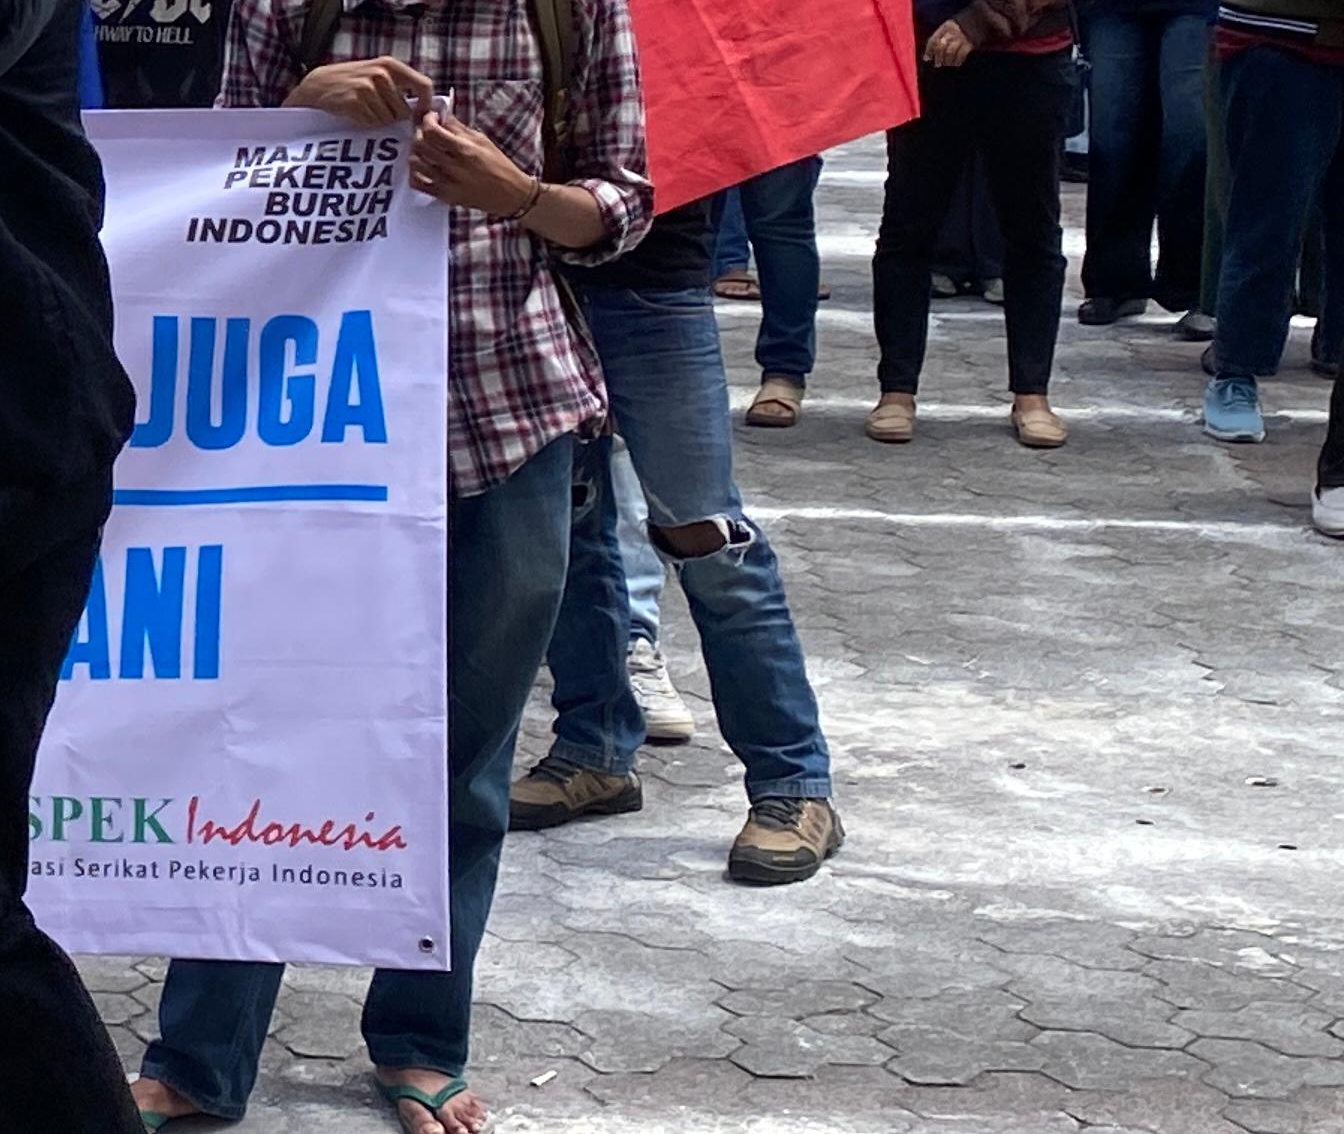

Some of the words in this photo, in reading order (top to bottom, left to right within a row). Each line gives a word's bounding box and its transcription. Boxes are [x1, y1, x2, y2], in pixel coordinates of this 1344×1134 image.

[136, 25, 155, 43] TO
[155, 26, 194, 45] HELL
[234, 137, 400, 169] MAJELIS
[223, 164, 395, 190] PEKERJA
[264, 189, 395, 217] BURUH
[186, 215, 388, 245] INDONESIA
[127, 310, 388, 451] JUGA
[59, 544, 223, 681] ANI
[29, 796, 175, 844] SPEK
[187, 795, 407, 851] Indonesia
[31, 859, 65, 877] asi
[73, 858, 159, 879] Serikat
[169, 860, 261, 886] Pekerja
[272, 863, 403, 889] Indonesia
